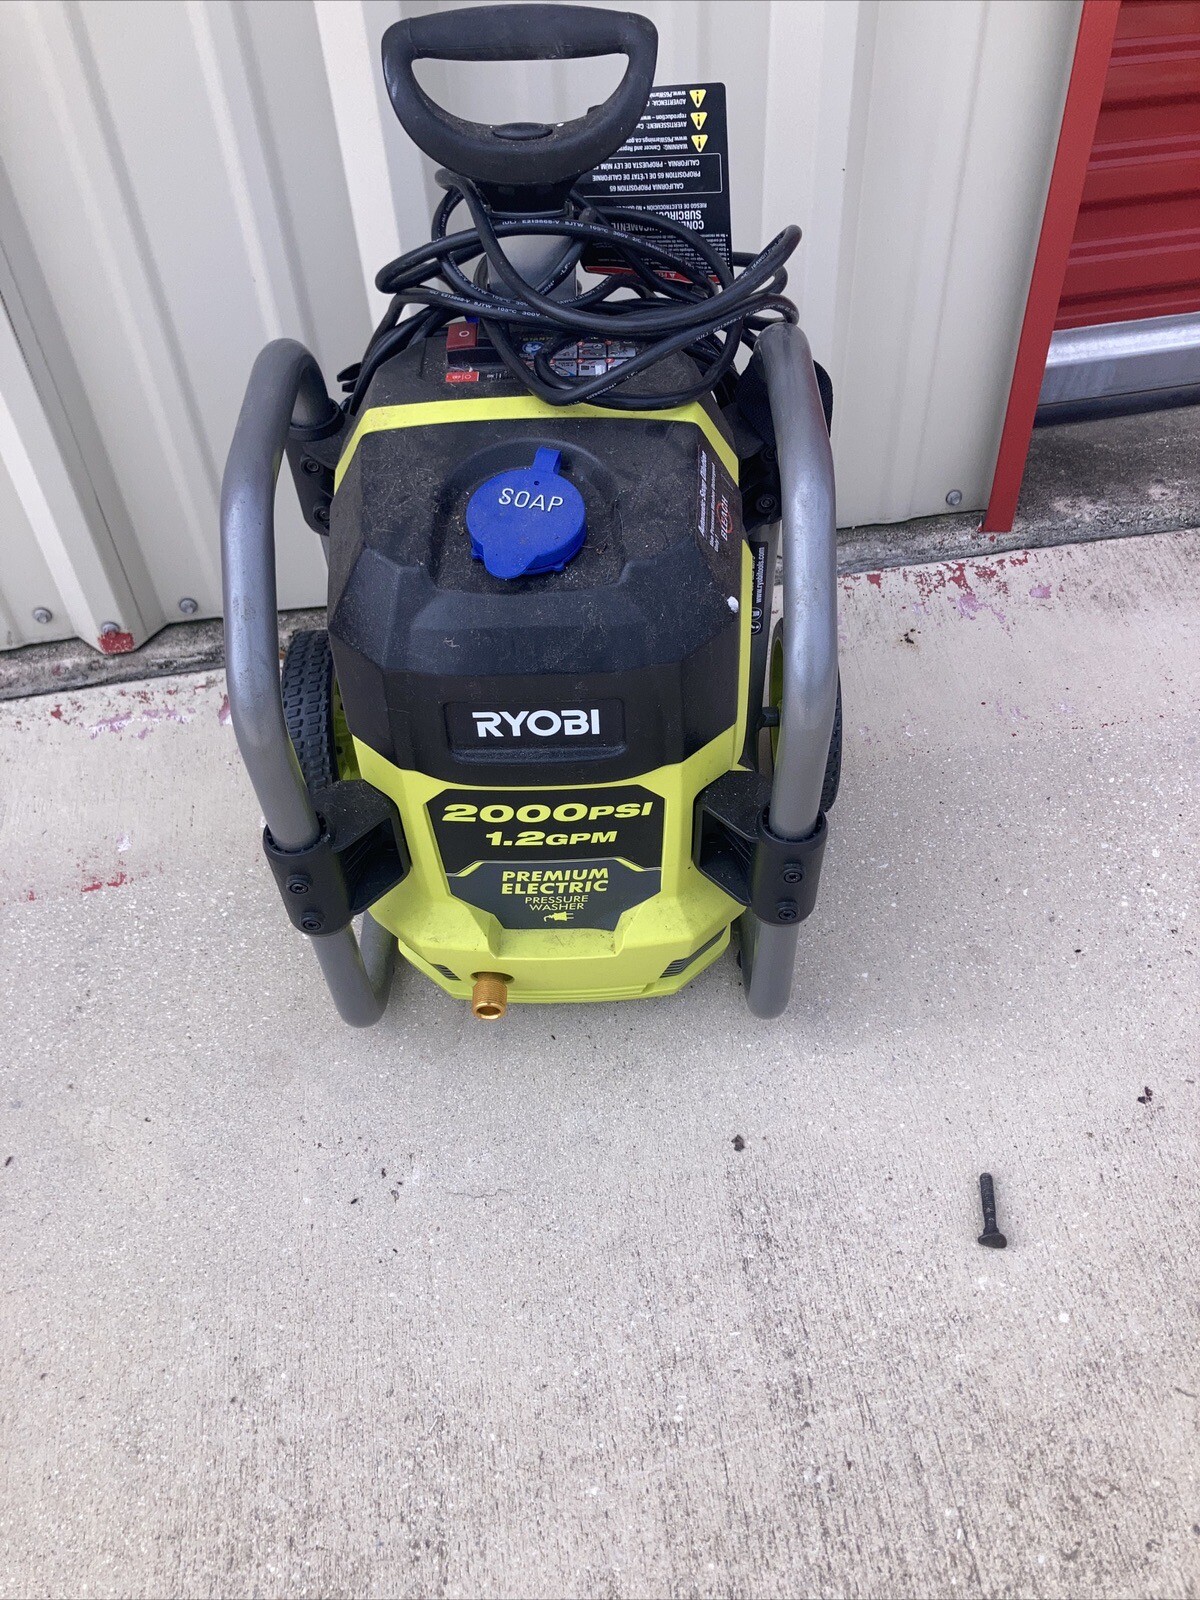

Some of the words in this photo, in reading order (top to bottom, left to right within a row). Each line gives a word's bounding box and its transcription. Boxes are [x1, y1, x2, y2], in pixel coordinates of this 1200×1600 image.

[655, 112, 687, 121] reproduction
[663, 142, 688, 151] WARNING:
[613, 162, 624, 170] LEY
[632, 161, 663, 170] PROPUESTA
[668, 159, 700, 168] CALIFORNIA
[592, 174, 623, 182] CALIFORNIE
[623, 173, 631, 181] DE
[649, 172, 657, 180] DE
[657, 171, 665, 179] 65
[665, 170, 701, 179] PROPOSITION
[617, 184, 652, 192] PROPOSITION
[652, 182, 684, 191] CALIFORNIA
[497, 487, 564, 513] SOAP
[721, 494, 729, 542] BLEACH
[756, 546, 766, 604] www.ryobitools.com
[471, 708, 601, 739] RYOBI
[501, 867, 609, 883] PREMIUM
[501, 879, 609, 896] ELECTRIC
[524, 894, 590, 905] PRESSURE
[528, 902, 585, 912] WASHER
